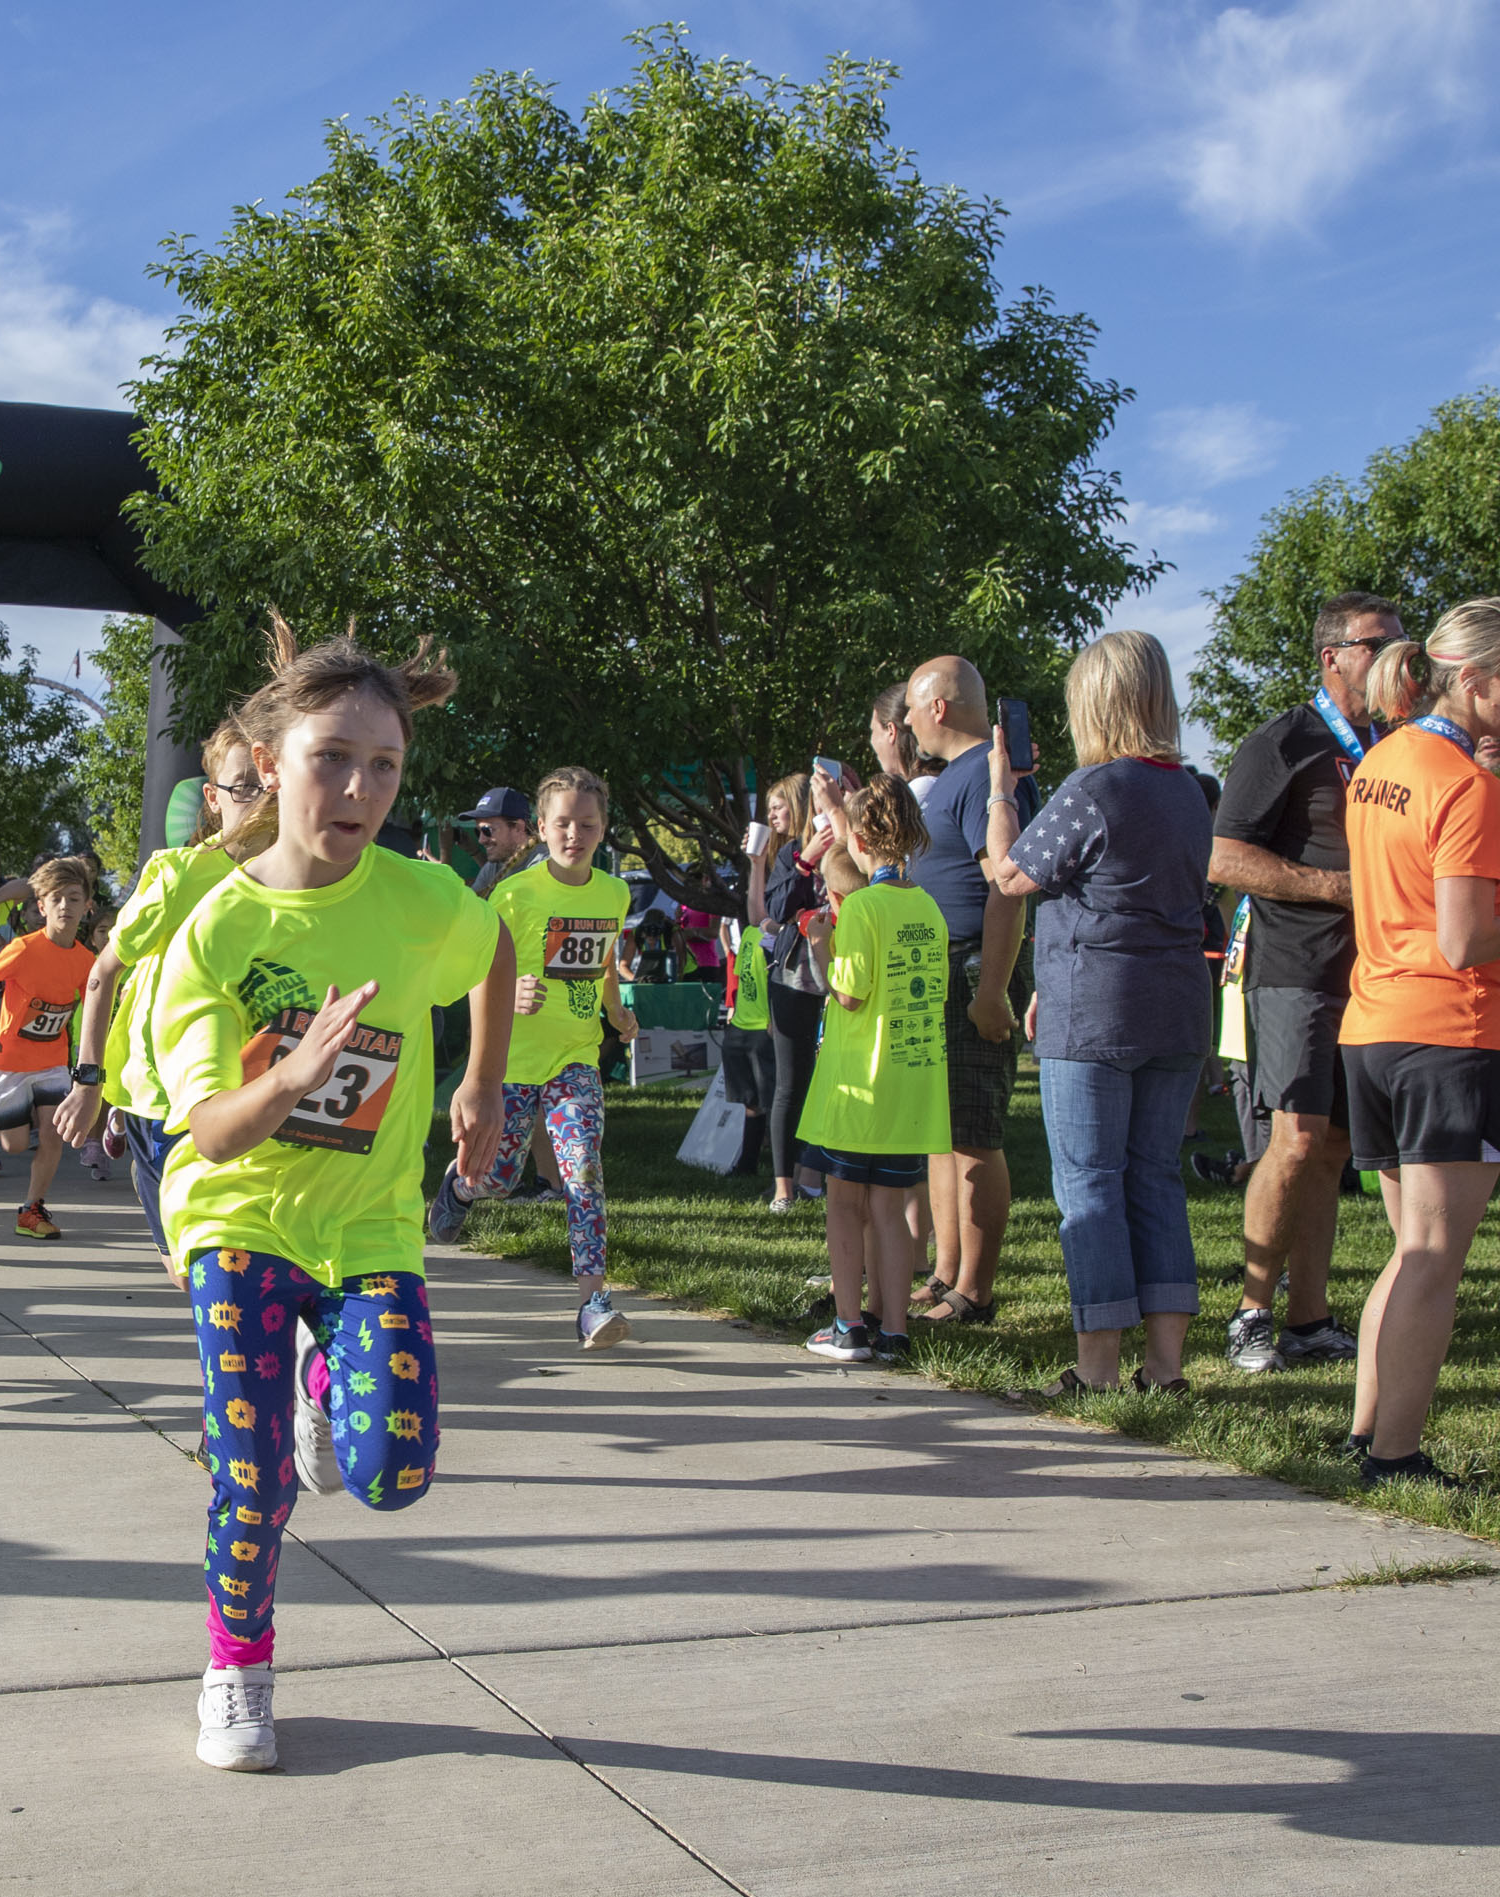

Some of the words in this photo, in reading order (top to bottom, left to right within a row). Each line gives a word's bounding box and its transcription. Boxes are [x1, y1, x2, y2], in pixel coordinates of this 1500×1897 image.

[573, 919, 595, 931] RUN
[896, 927, 936, 943] SPONSORS
[560, 936, 607, 965] 881
[32, 1013, 66, 1033] 911
[350, 1028, 401, 1057] UTAH
[213, 1309, 236, 1321] COOL
[394, 1417, 418, 1431] COOL
[232, 1465, 255, 1481] COOL
[223, 1579, 245, 1592] COOL
